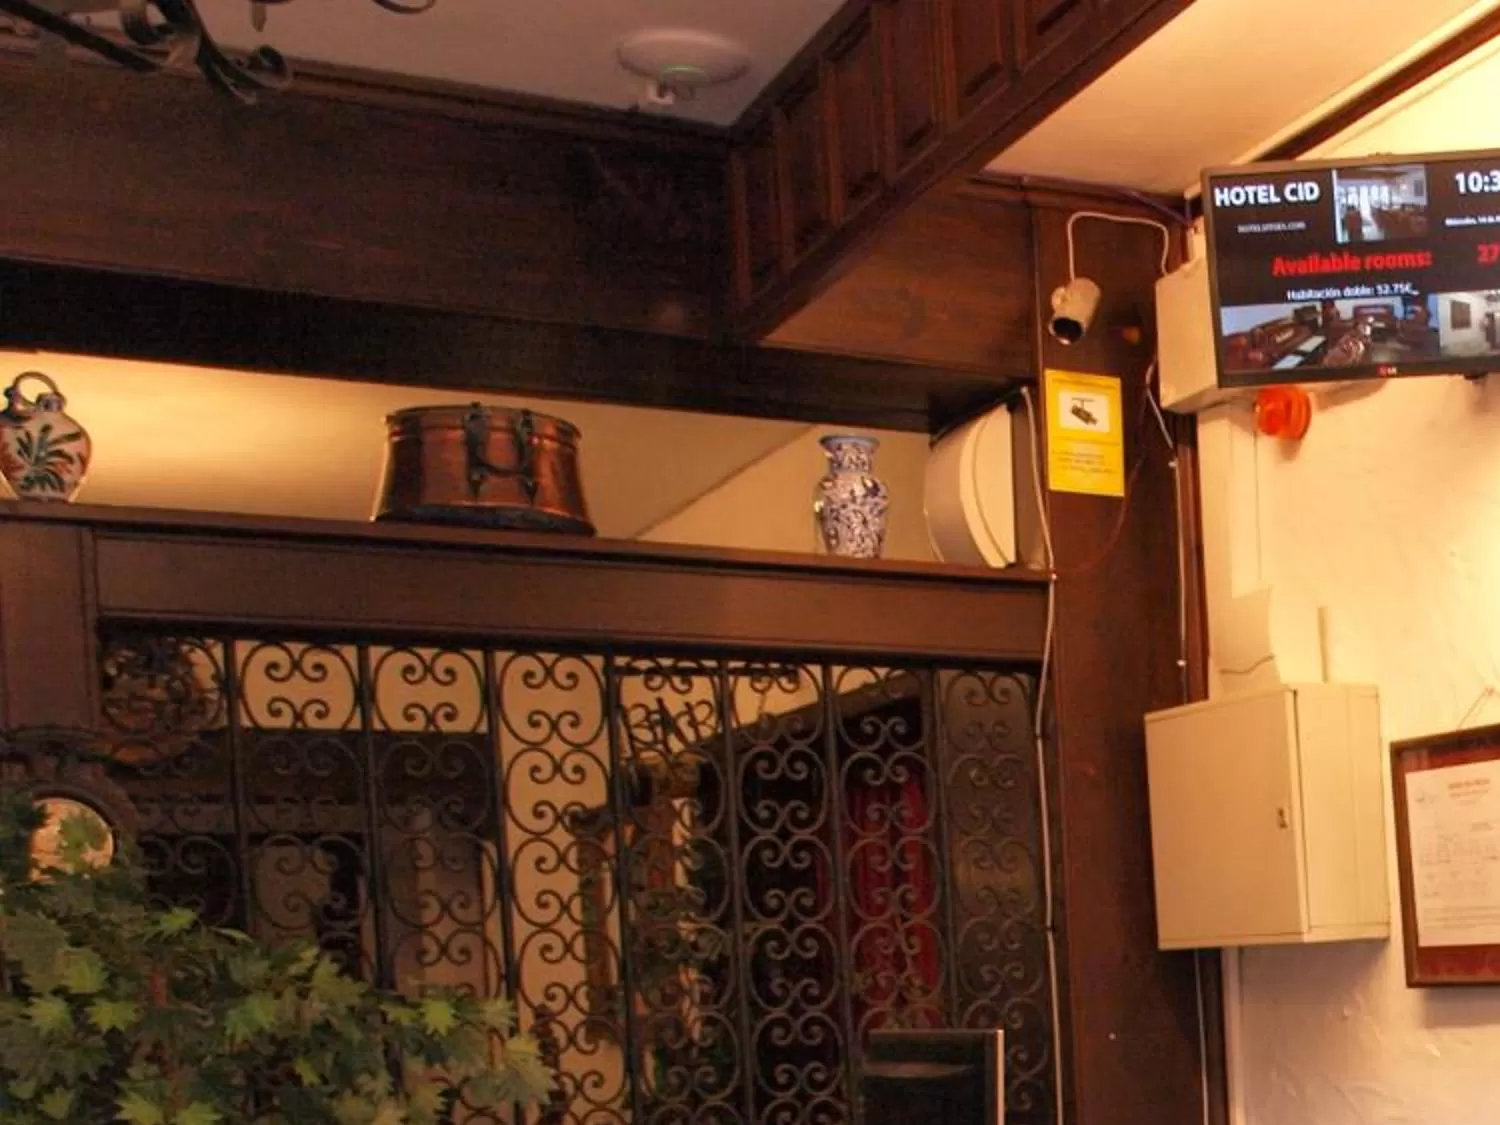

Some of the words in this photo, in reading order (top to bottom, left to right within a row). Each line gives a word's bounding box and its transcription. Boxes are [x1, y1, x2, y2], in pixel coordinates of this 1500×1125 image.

[1214, 186, 1281, 207] HOTEL
[1284, 181, 1322, 201] CID
[1272, 252, 1361, 277] Available
[1364, 251, 1433, 269] rooms:
